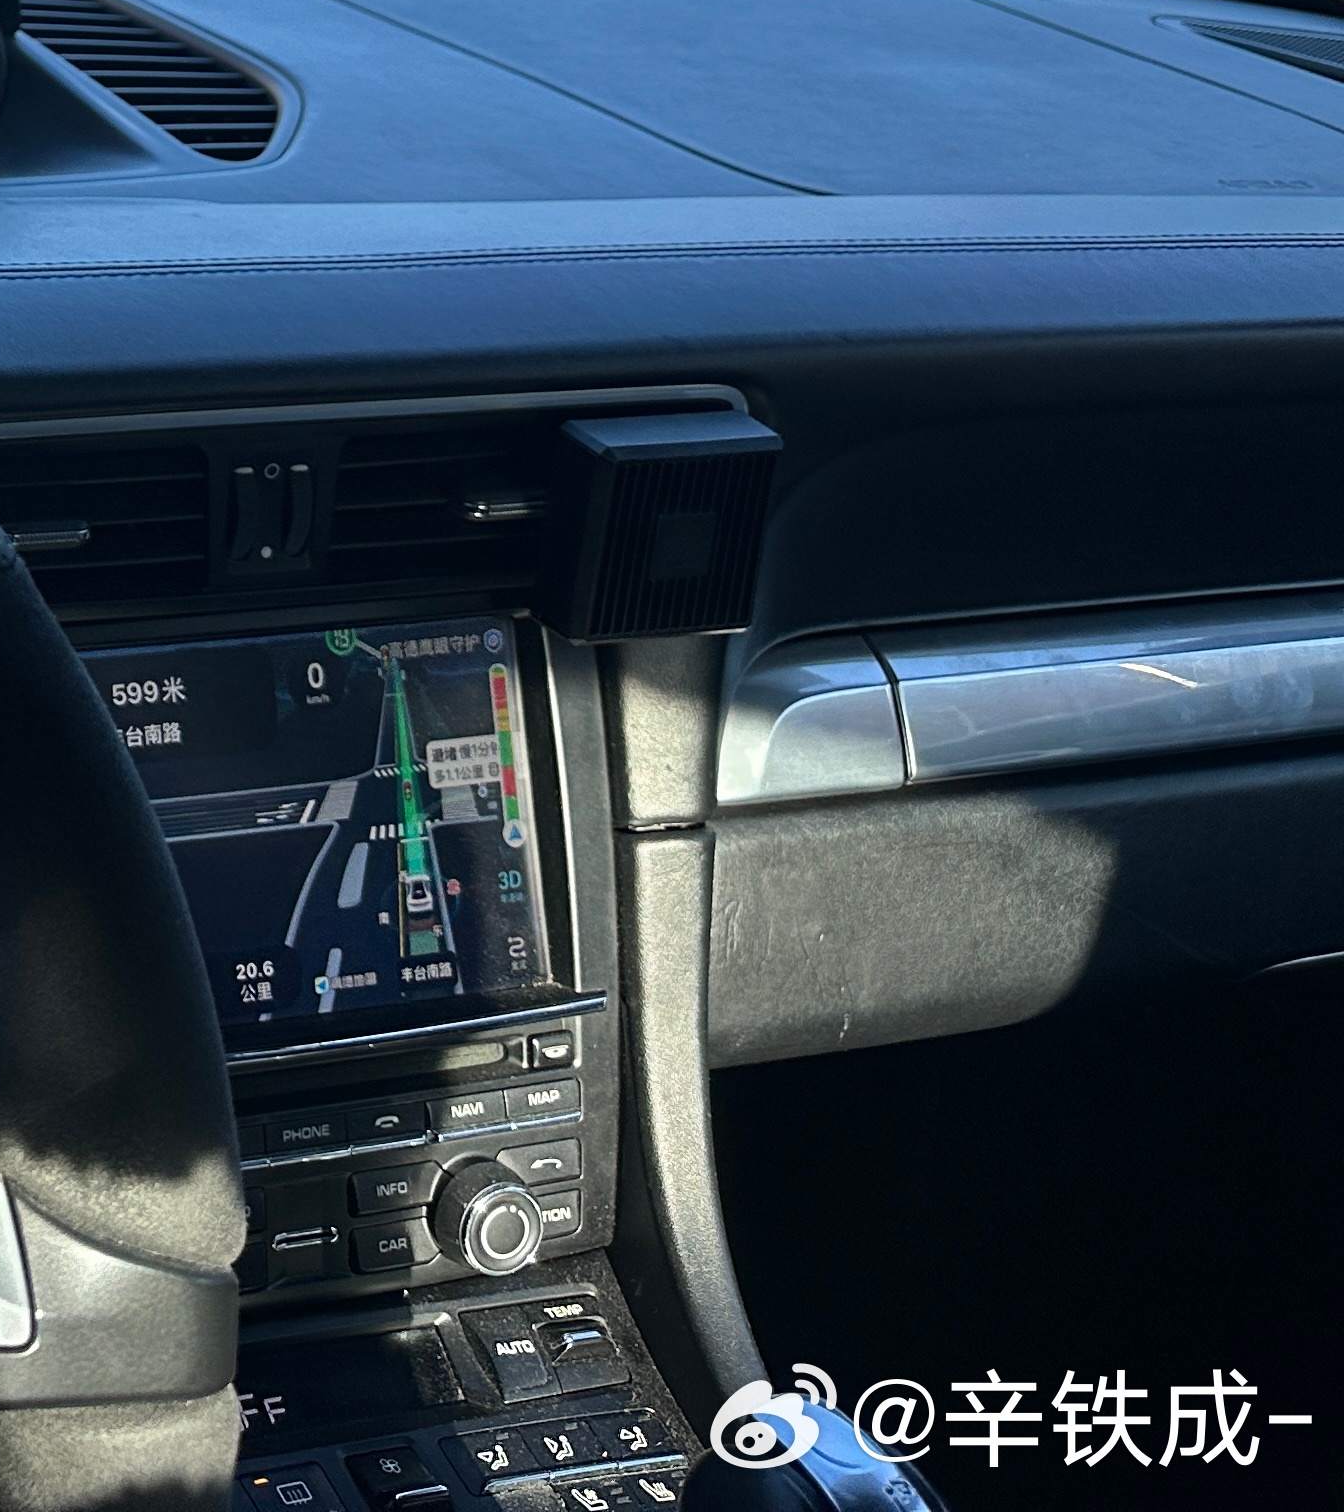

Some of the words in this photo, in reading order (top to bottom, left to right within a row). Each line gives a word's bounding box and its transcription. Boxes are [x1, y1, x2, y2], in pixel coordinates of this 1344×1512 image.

[306, 662, 325, 689] 0
[498, 869, 522, 891] 3D
[235, 960, 274, 980] 20.6
[240, 982, 273, 1002] 公里
[528, 1090, 560, 1106] MAP
[450, 1101, 485, 1119] NAVI
[282, 1124, 330, 1142] PHONE
[376, 1182, 408, 1197] INFO
[378, 1237, 408, 1253] CAR
[544, 1303, 583, 1318] TEMP
[495, 1339, 536, 1357] AUTO
